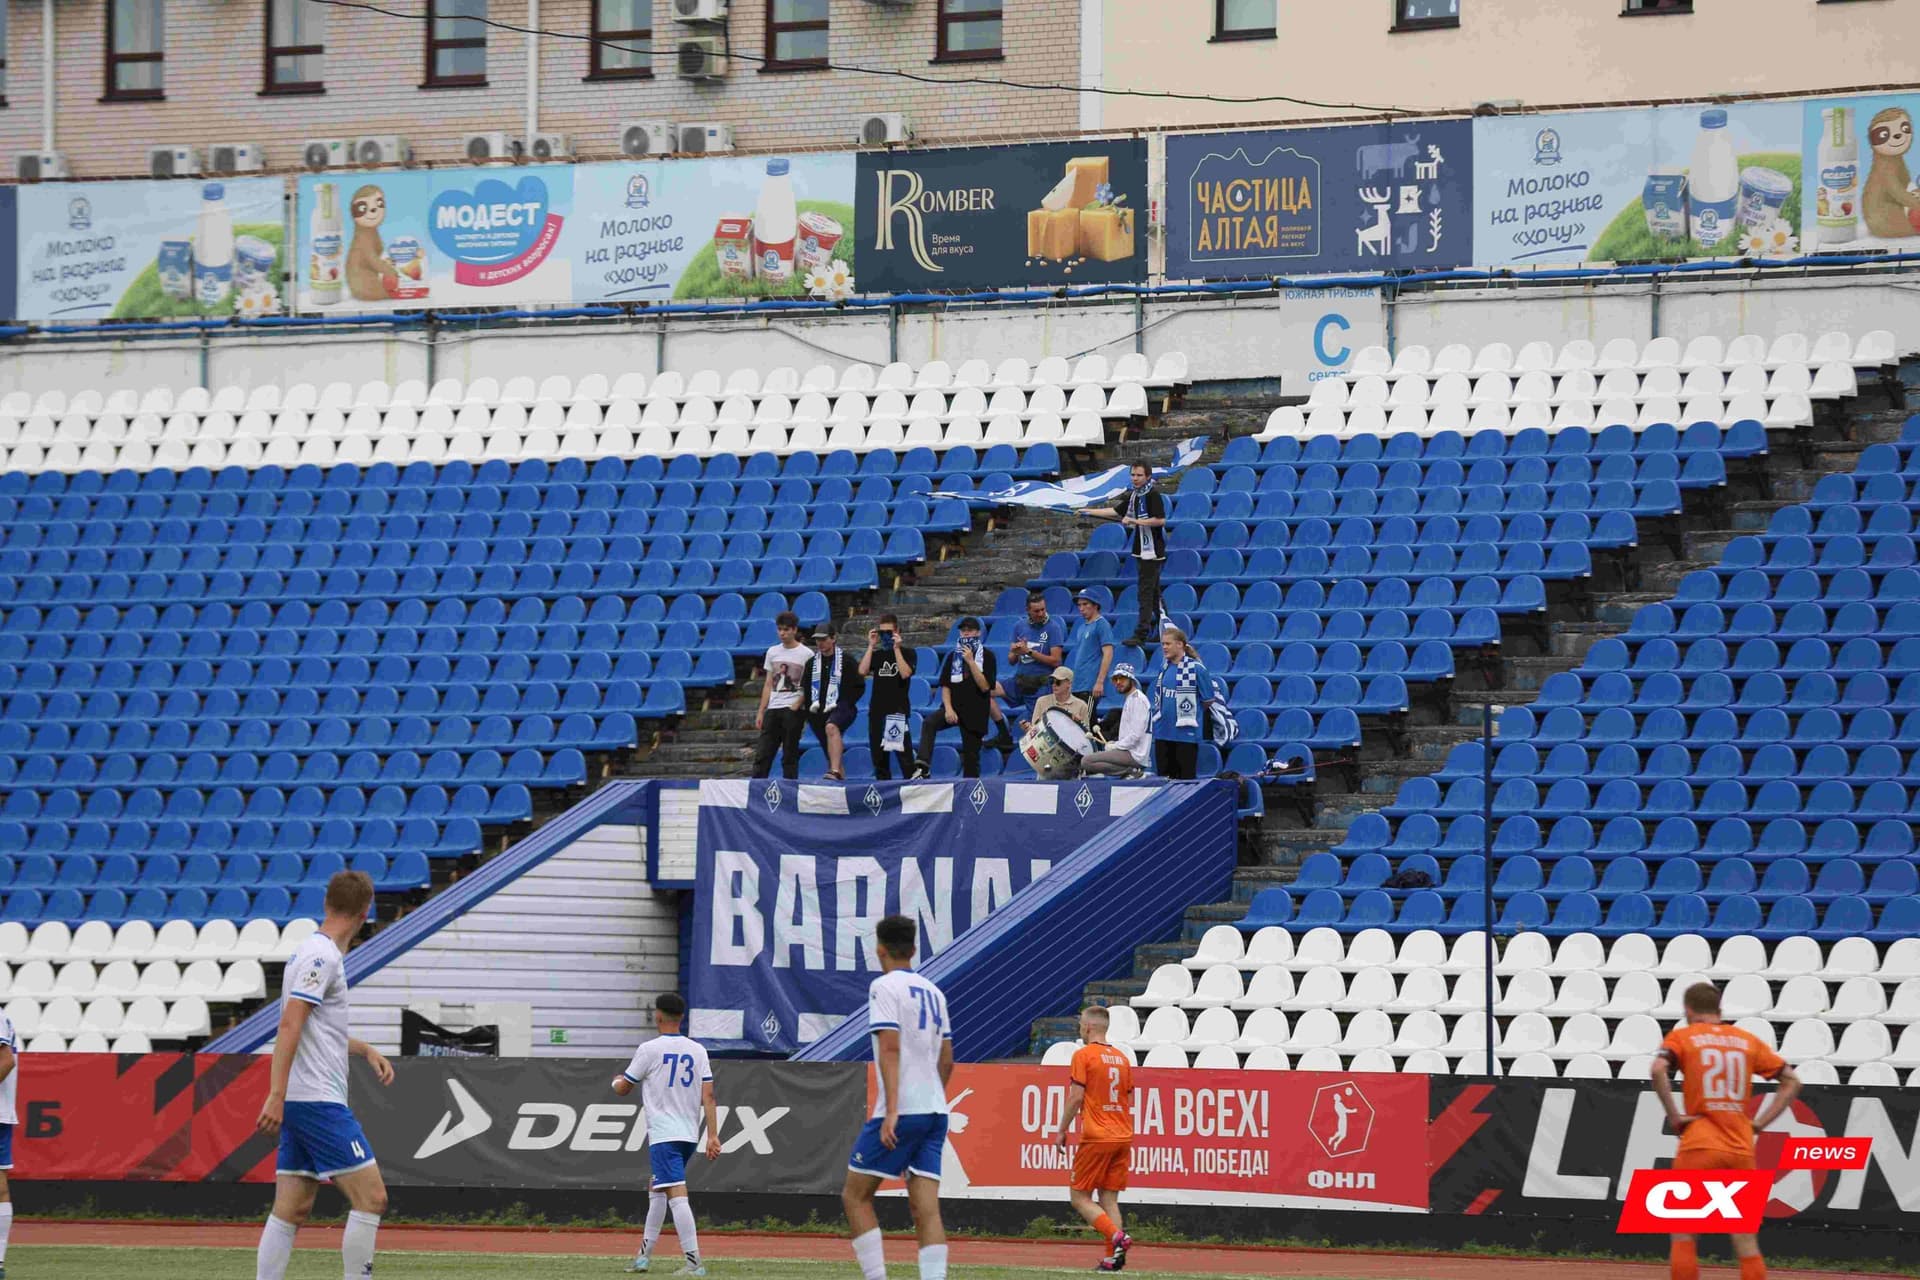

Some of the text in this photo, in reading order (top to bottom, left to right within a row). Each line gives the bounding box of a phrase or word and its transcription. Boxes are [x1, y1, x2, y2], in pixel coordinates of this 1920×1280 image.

[1197, 176, 1312, 215] ЧАСТИЦА
[1507, 170, 1590, 198] Молоко
[437, 202, 541, 231] МОДЕСТ
[1491, 194, 1604, 226] на разные
[600, 214, 673, 239] Молоко
[931, 234, 961, 246] Время
[1197, 215, 1278, 252] АЛТАЯ
[1512, 223, 1586, 246] «хочу»
[585, 236, 684, 264] на разные
[931, 245, 974, 256] для вкуса
[603, 263, 669, 285] «хочу»
[1285, 288, 1375, 300] ЮЖНАЯ ТРИБУНА
[710, 851, 1051, 971] BARNA
[909, 986, 943, 1035] 74
[663, 1054, 694, 1087] 73
[1108, 1067, 1120, 1102] 2
[1701, 1048, 1747, 1101] 20
[1174, 1088, 1269, 1138] ВСЕХ!
[350, 1140, 365, 1159] 4
[1128, 1147, 1189, 1176] ДИНА,
[1193, 1148, 1269, 1177] ПОБЕДА!
[1308, 1169, 1376, 1189] ФНЛ
